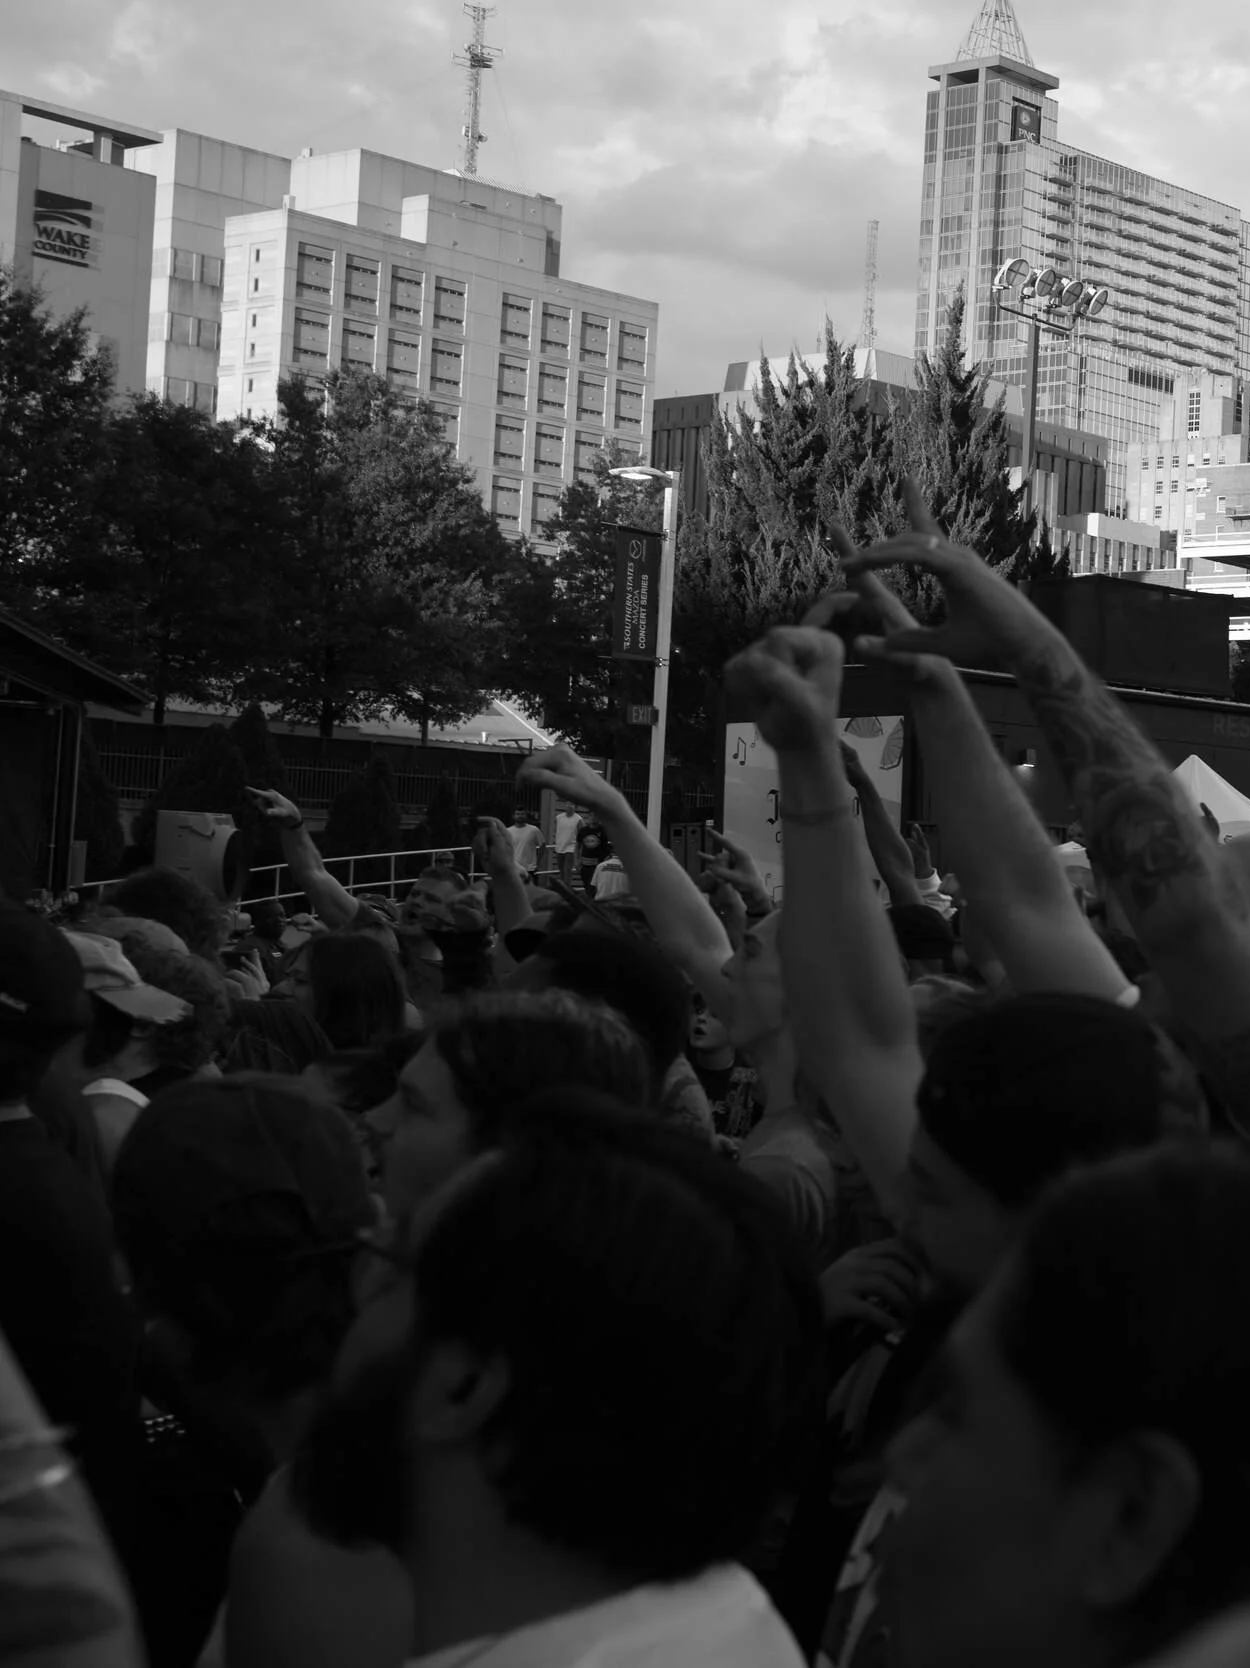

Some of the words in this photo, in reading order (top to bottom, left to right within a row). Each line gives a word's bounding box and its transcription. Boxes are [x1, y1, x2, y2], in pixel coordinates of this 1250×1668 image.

[1018, 127, 1036, 143] PNC
[33, 223, 91, 249] WAKE
[34, 239, 88, 260] COUNTY
[626, 561, 634, 592] STATES
[640, 574, 649, 606] SERIES
[624, 593, 633, 642] SOUTHERN
[632, 589, 640, 625] MAZDA
[638, 607, 647, 649] CONCERT
